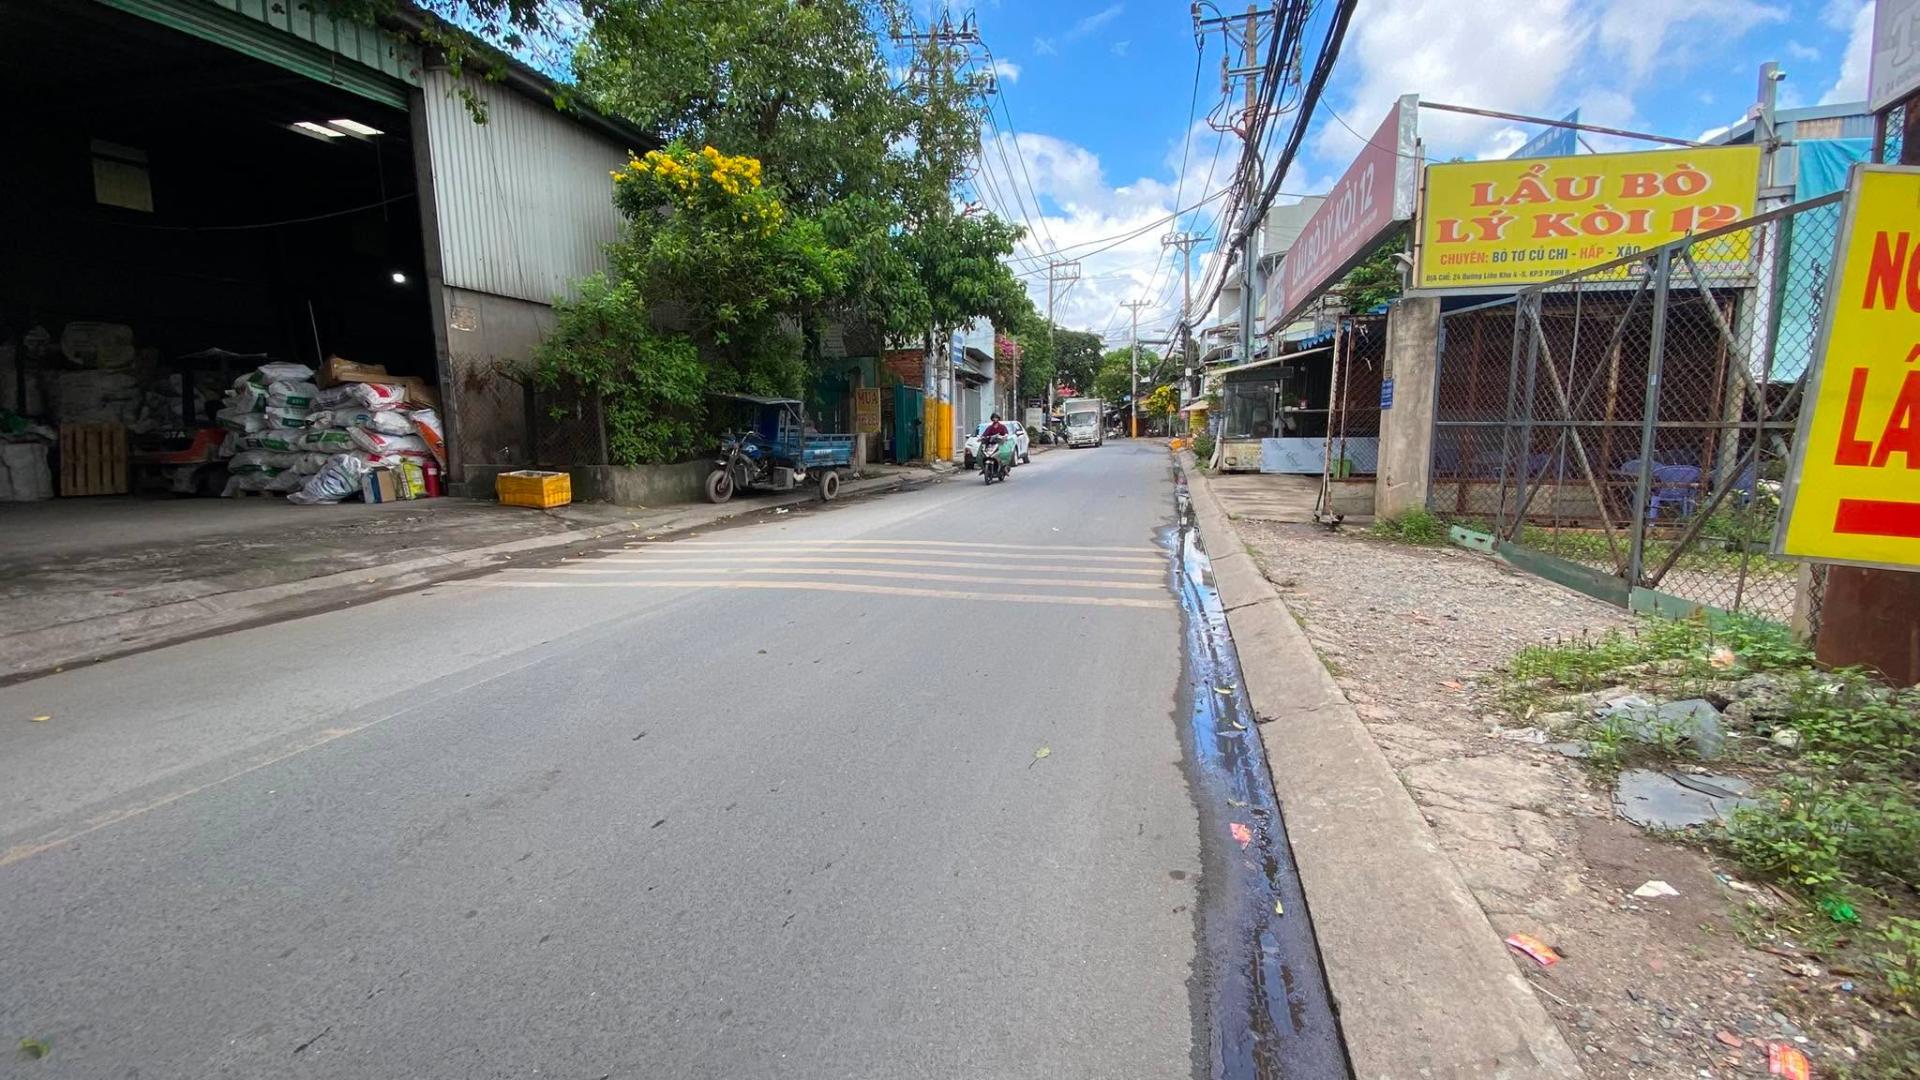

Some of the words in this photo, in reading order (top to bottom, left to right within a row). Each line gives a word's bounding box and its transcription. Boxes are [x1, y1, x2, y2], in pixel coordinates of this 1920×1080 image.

[1360, 162, 1375, 215] 12
[1470, 163, 1603, 207] LẨU
[1618, 163, 1711, 199] BÒ
[1435, 209, 1517, 243] LÝ
[1532, 204, 1651, 239] KÒI
[1671, 204, 1740, 233] 12
[1548, 248, 1568, 261] CHI
